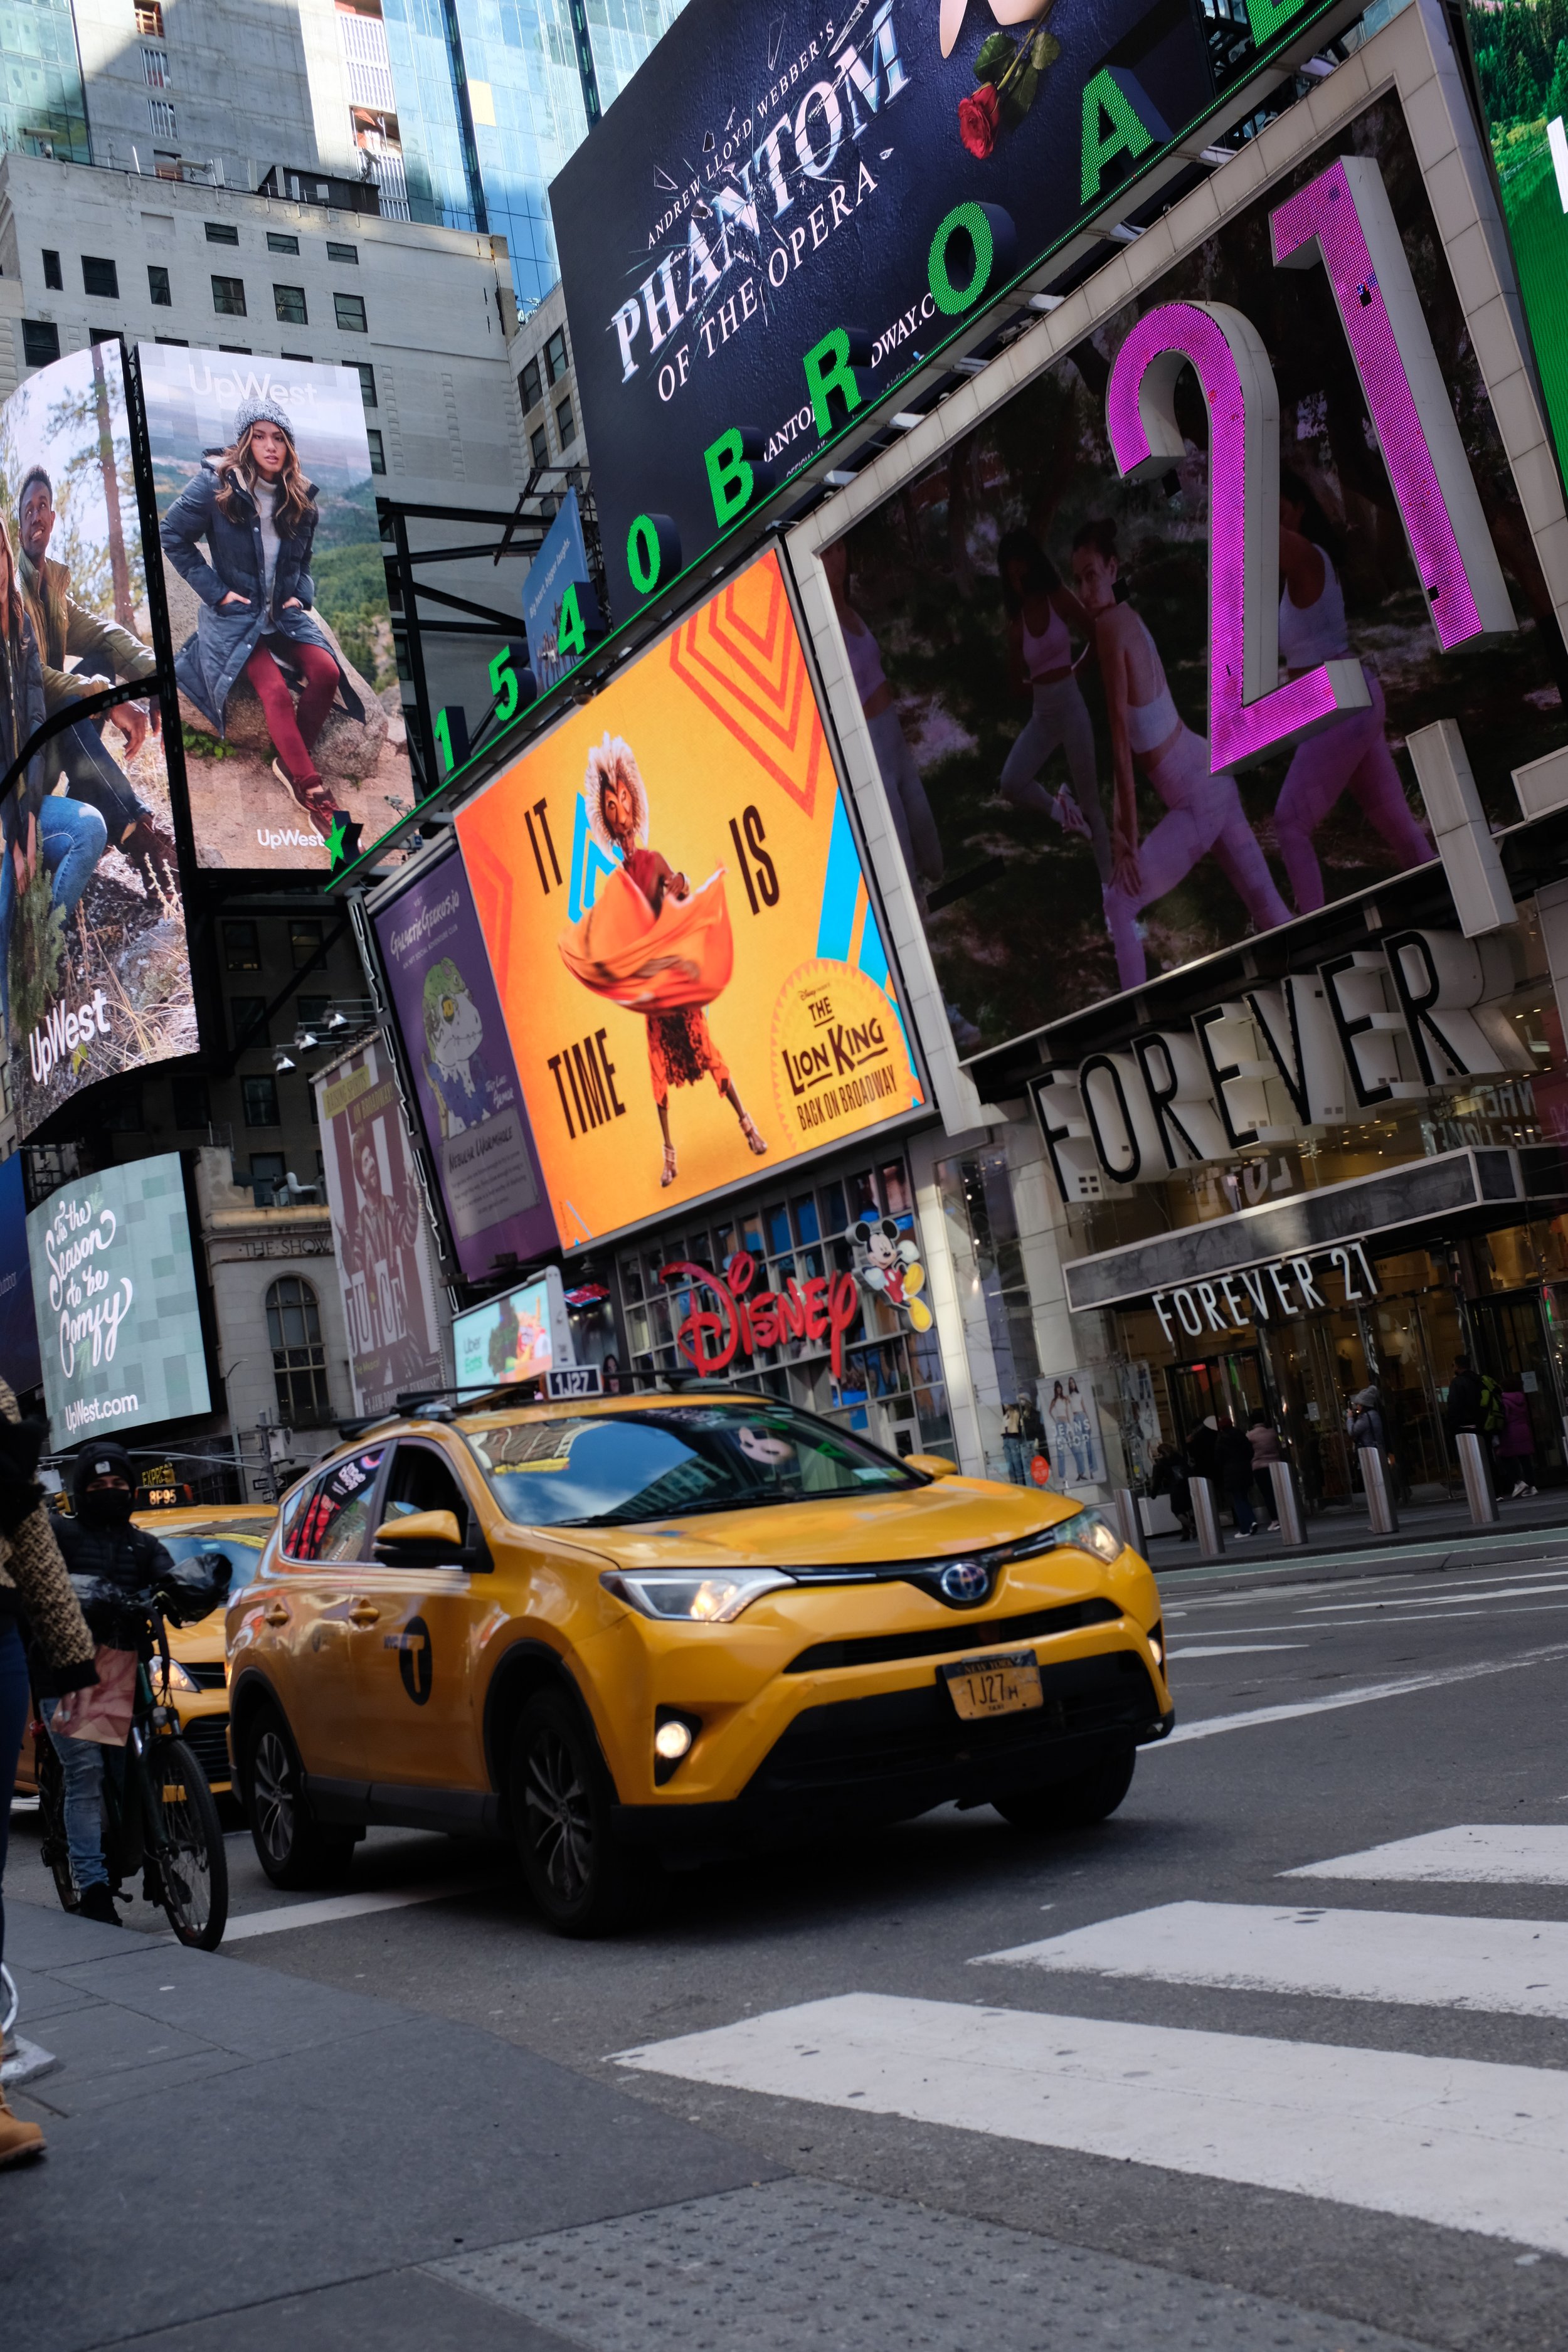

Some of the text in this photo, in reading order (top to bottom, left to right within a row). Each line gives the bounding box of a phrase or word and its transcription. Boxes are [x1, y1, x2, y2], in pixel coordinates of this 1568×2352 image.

[648, 20, 835, 250] ANDREW LLOYD WEBBER'S
[611, 0, 911, 383] PHANTOM
[659, 161, 878, 401] OF THE OPERA
[189, 363, 317, 406] UpWest
[1106, 158, 1505, 774] 21
[524, 798, 780, 915] IT IS
[29, 988, 111, 1086] UpWest
[808, 996, 833, 1022] THE
[548, 1027, 626, 1140] TIME
[781, 1017, 885, 1096] LION KING
[1027, 930, 1480, 1203] FOREVER
[797, 1064, 898, 1131] BACK ON BROADWAY
[65, 1200, 92, 1231] the
[242, 1237, 328, 1256] THE SHOW
[45, 1209, 117, 1311] Season
[66, 1265, 109, 1308] to be
[1152, 1242, 1378, 1342] FOREVER 21
[60, 1278, 133, 1379] Comfy
[65, 1394, 139, 1434] UpWest.com
[555, 1372, 589, 1394] 1J27
[1051, 1419, 1091, 1438] JEANS
[1057, 1434, 1089, 1450] SHOP
[149, 1489, 176, 1505] 8P95
